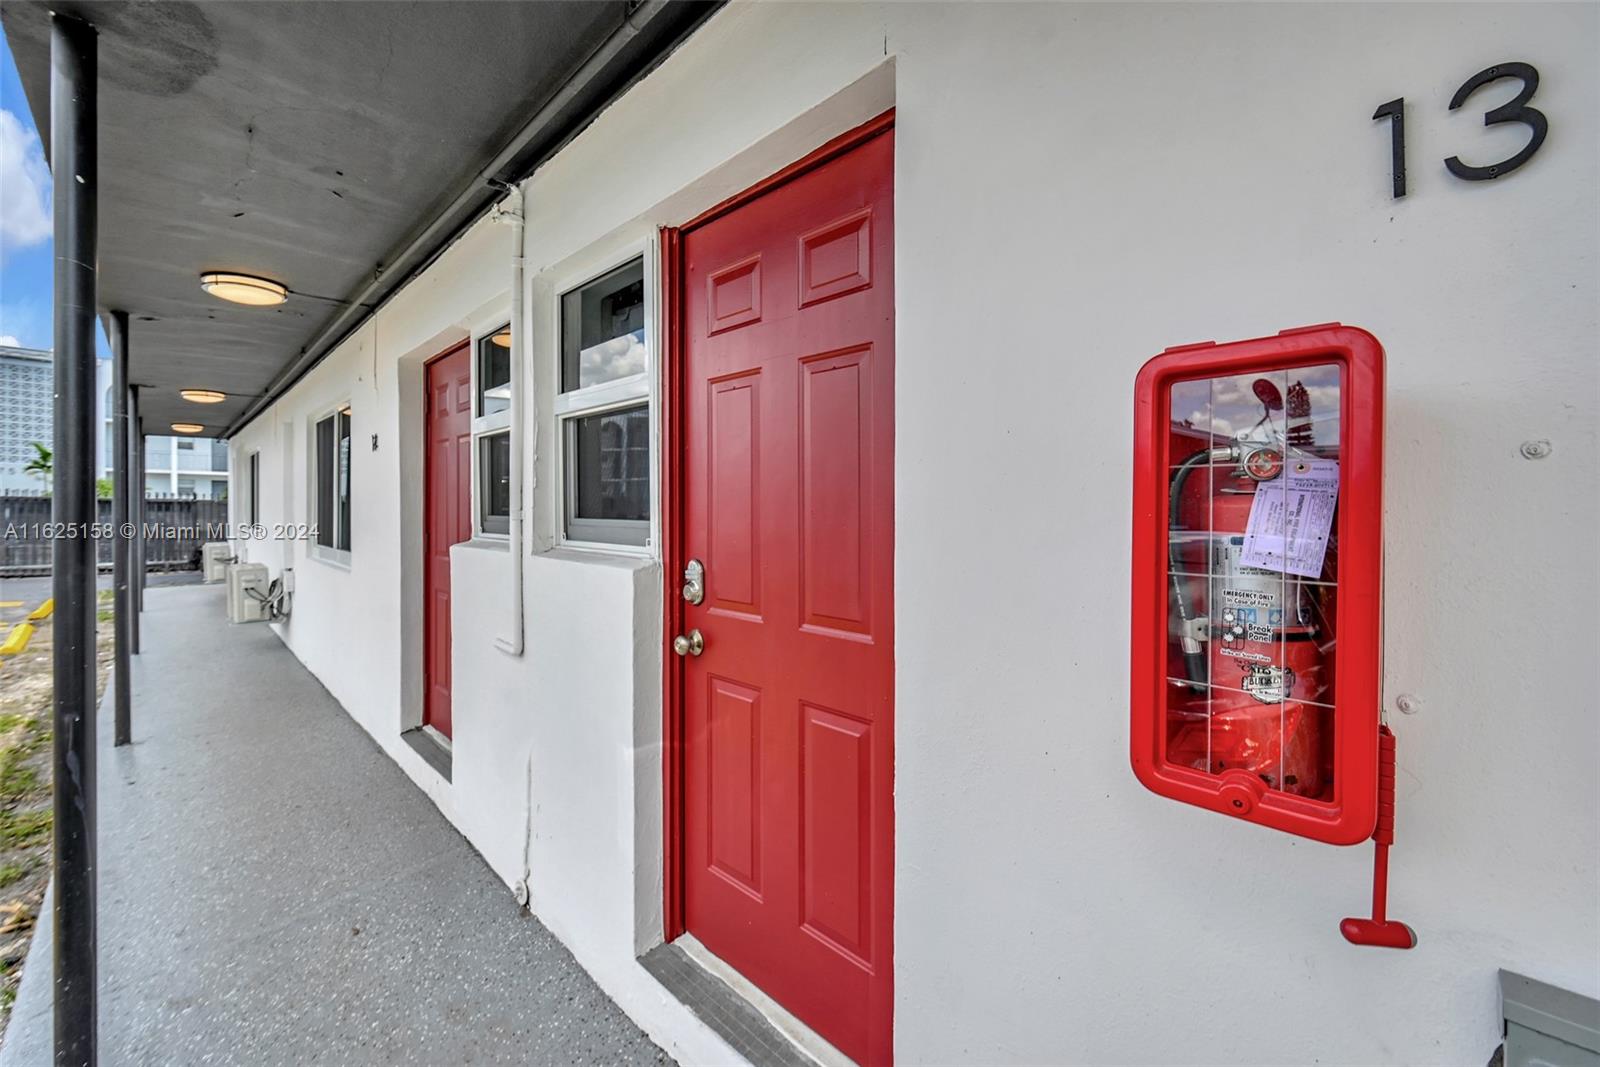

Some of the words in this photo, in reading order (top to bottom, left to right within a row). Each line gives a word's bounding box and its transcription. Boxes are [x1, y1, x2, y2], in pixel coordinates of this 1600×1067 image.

[1372, 61, 1548, 199] 13
[1223, 589, 1256, 599] EMERGENCY
[1248, 623, 1272, 633] Break
[1248, 633, 1271, 642] Panel
